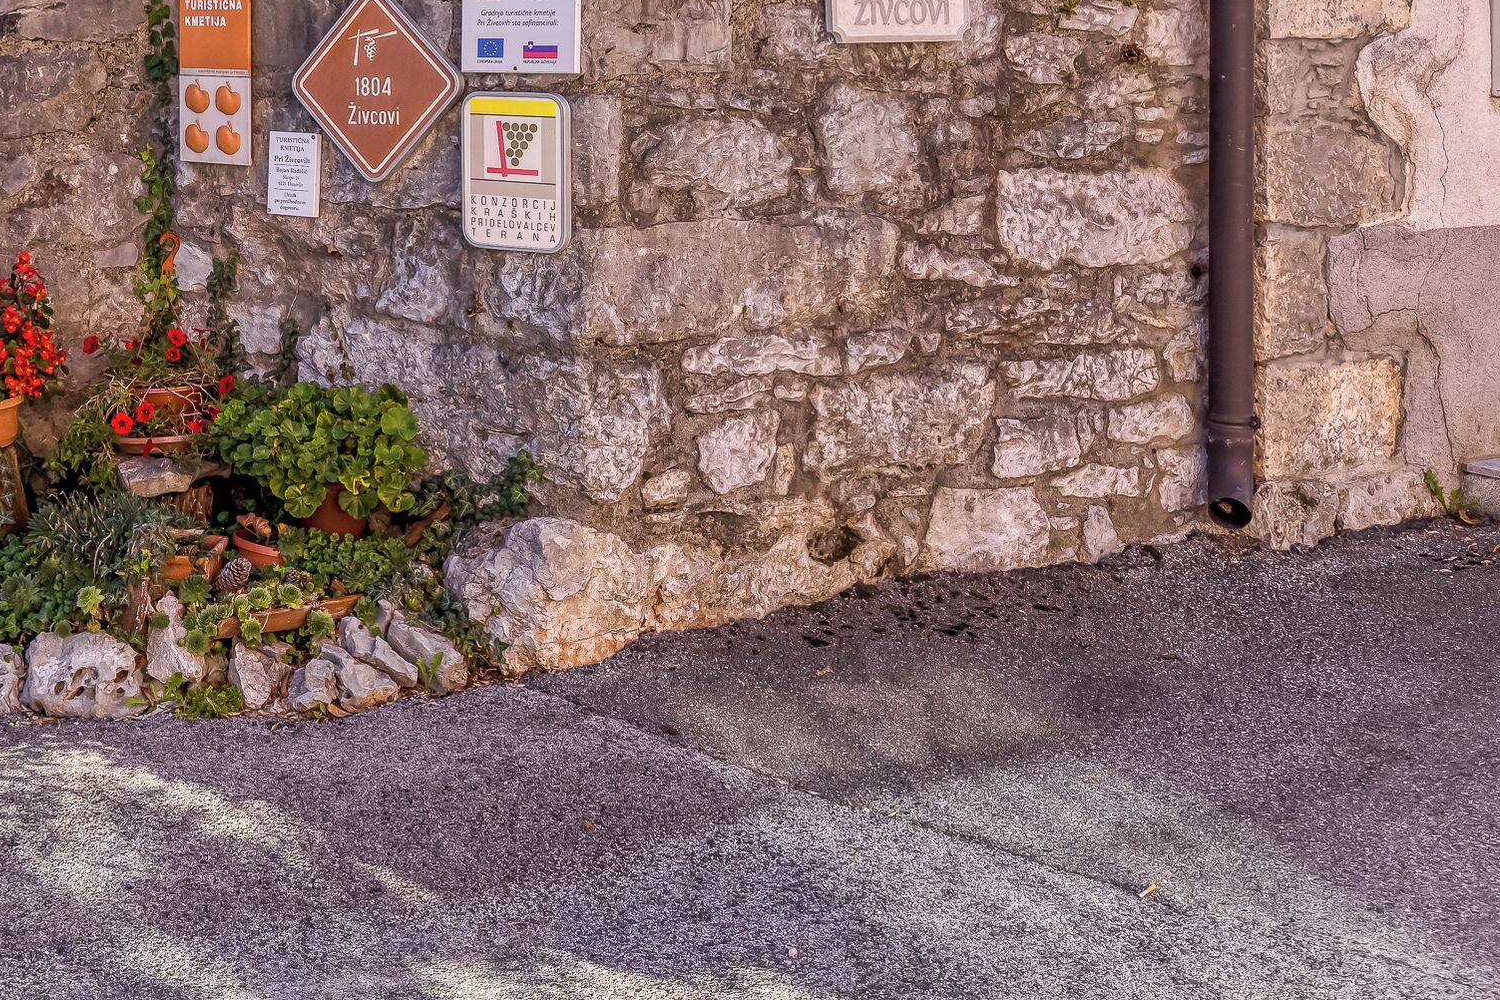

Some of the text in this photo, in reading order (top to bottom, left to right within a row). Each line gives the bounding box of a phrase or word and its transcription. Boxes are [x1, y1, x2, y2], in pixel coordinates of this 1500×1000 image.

[480, 8, 556, 18] Gradnjo turistične kmetije
[184, 15, 227, 27] KMETIJA
[355, 76, 391, 96] 1804
[348, 101, 400, 125] Živcovi
[276, 136, 310, 144] TURISTIČNA
[280, 145, 305, 153] KMETIJA
[274, 155, 284, 163] Pri
[470, 195, 556, 210] KONZORCIJ
[470, 207, 556, 221] KRAŠKIH
[470, 216, 556, 232] PRIDELOVALCEV
[471, 227, 556, 243] TERANA
